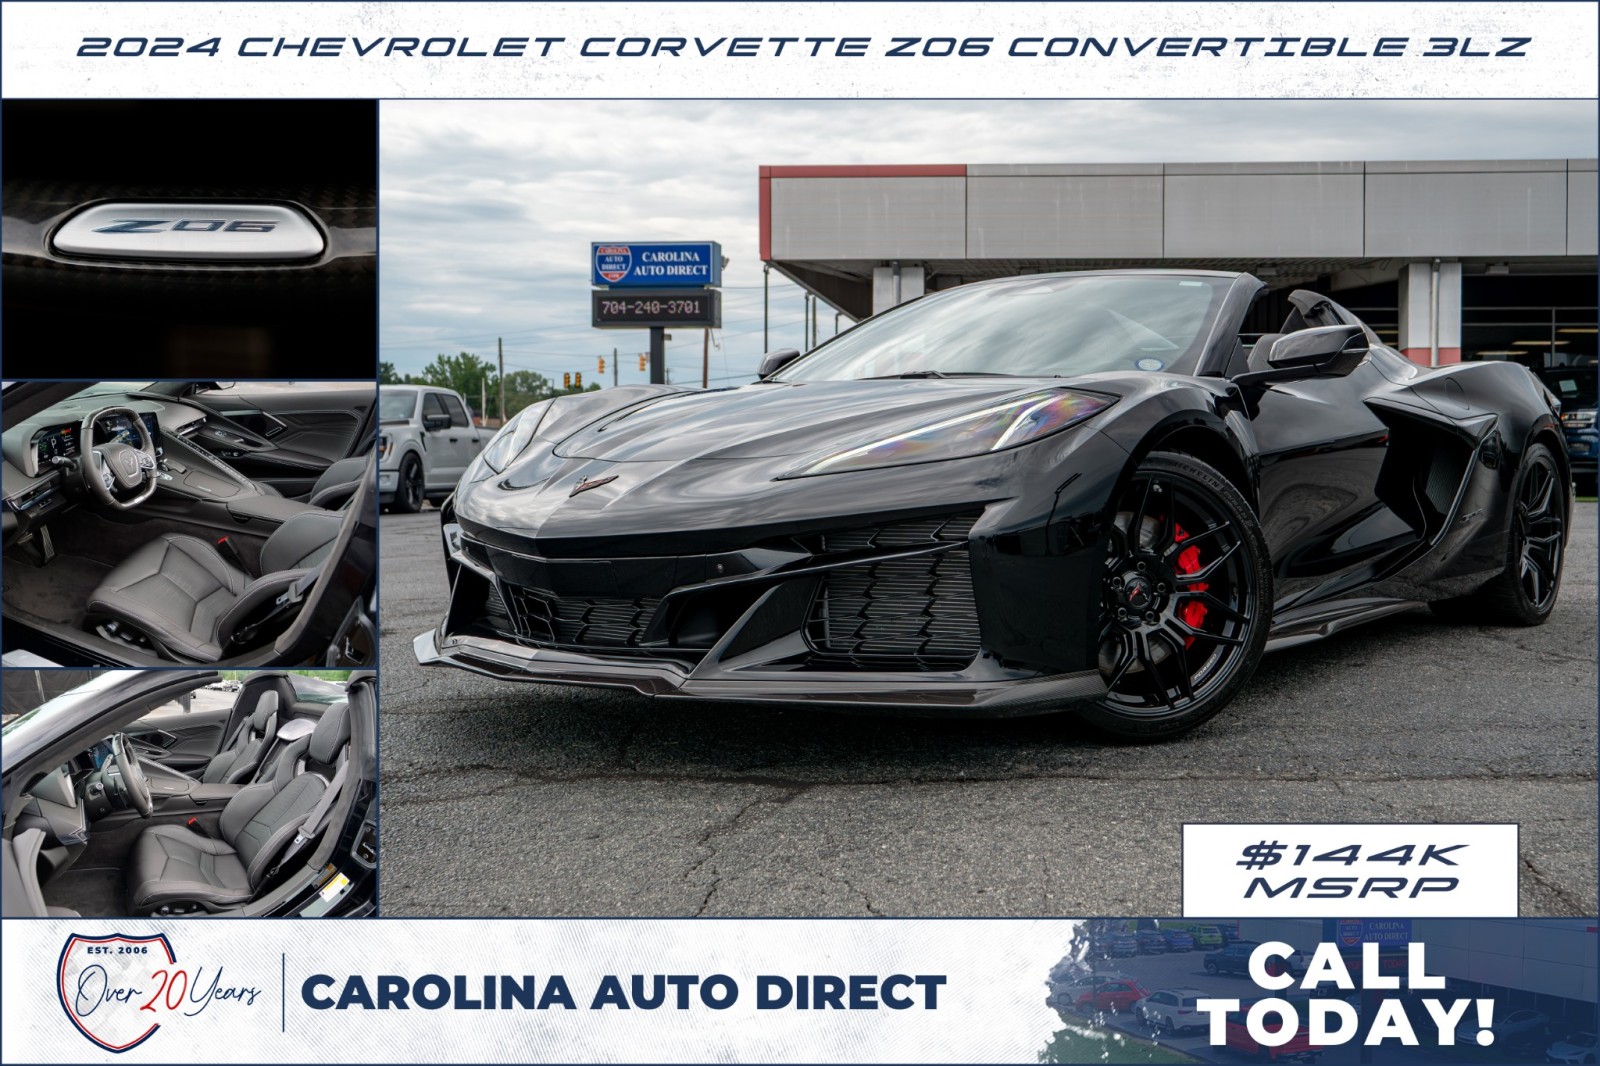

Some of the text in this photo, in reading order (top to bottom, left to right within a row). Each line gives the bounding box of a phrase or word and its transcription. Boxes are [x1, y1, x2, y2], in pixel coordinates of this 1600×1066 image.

[92, 218, 281, 235] Z06
[641, 251, 701, 263] CAROLINA
[601, 263, 627, 271] DIRECT
[634, 265, 708, 277] AUTO DIRECT
[601, 300, 701, 315] 704-240-3701
[1369, 921, 1405, 930] CAROLINA
[1364, 932, 1384, 941] AUTO
[1384, 931, 1409, 941] DIRECT
